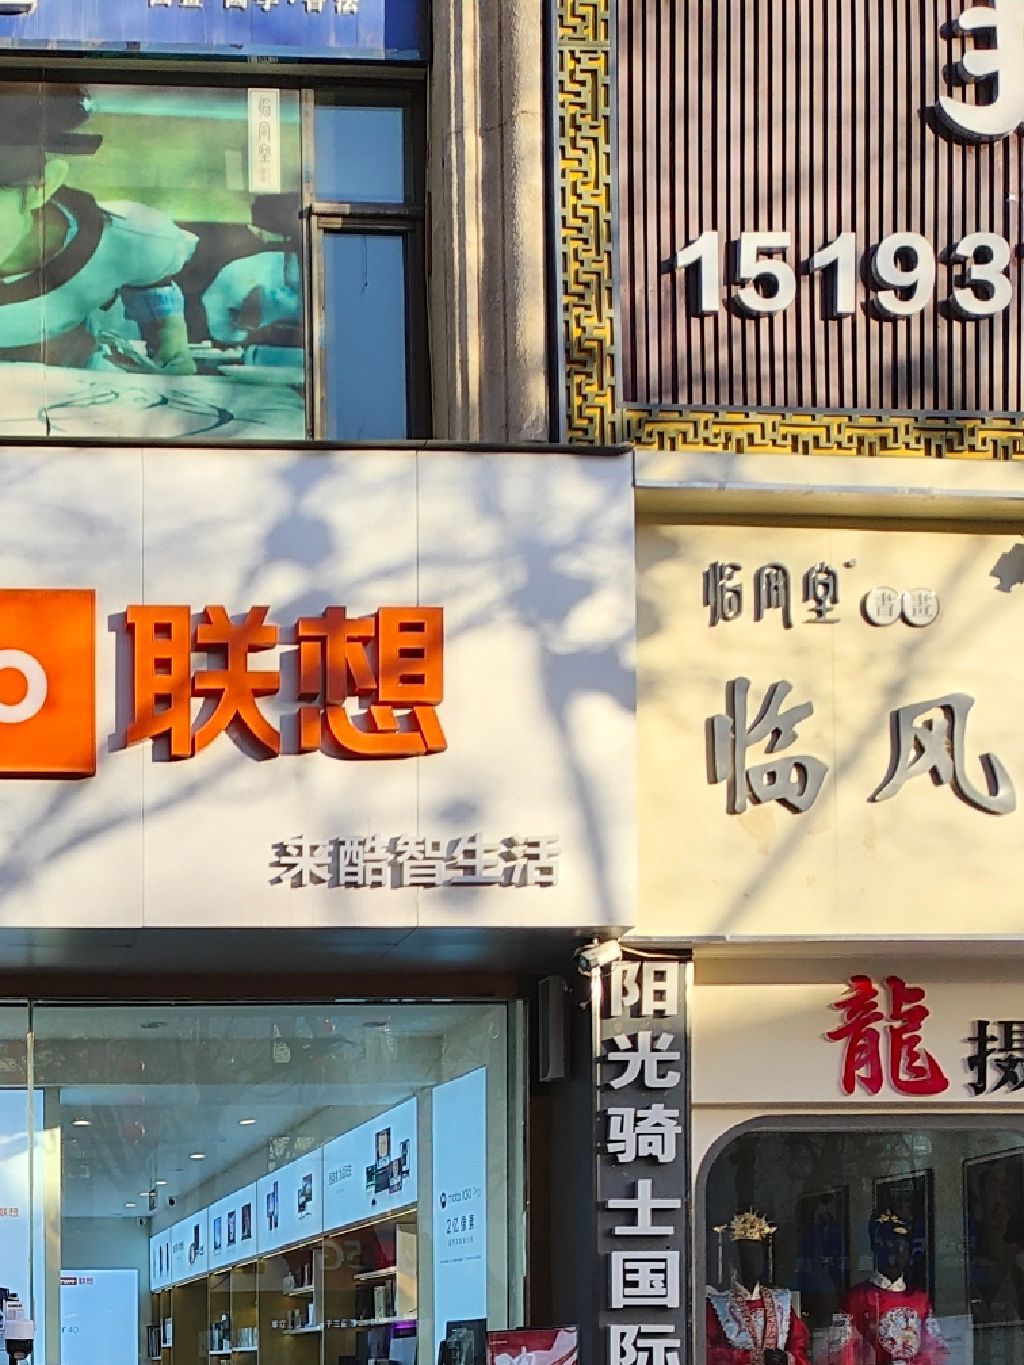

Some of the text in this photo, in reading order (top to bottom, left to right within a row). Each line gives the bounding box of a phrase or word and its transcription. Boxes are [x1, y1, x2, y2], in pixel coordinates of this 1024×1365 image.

[676, 231, 1012, 317] 15193
[124, 604, 448, 760] 联想
[272, 832, 560, 889] 来酷智生活
